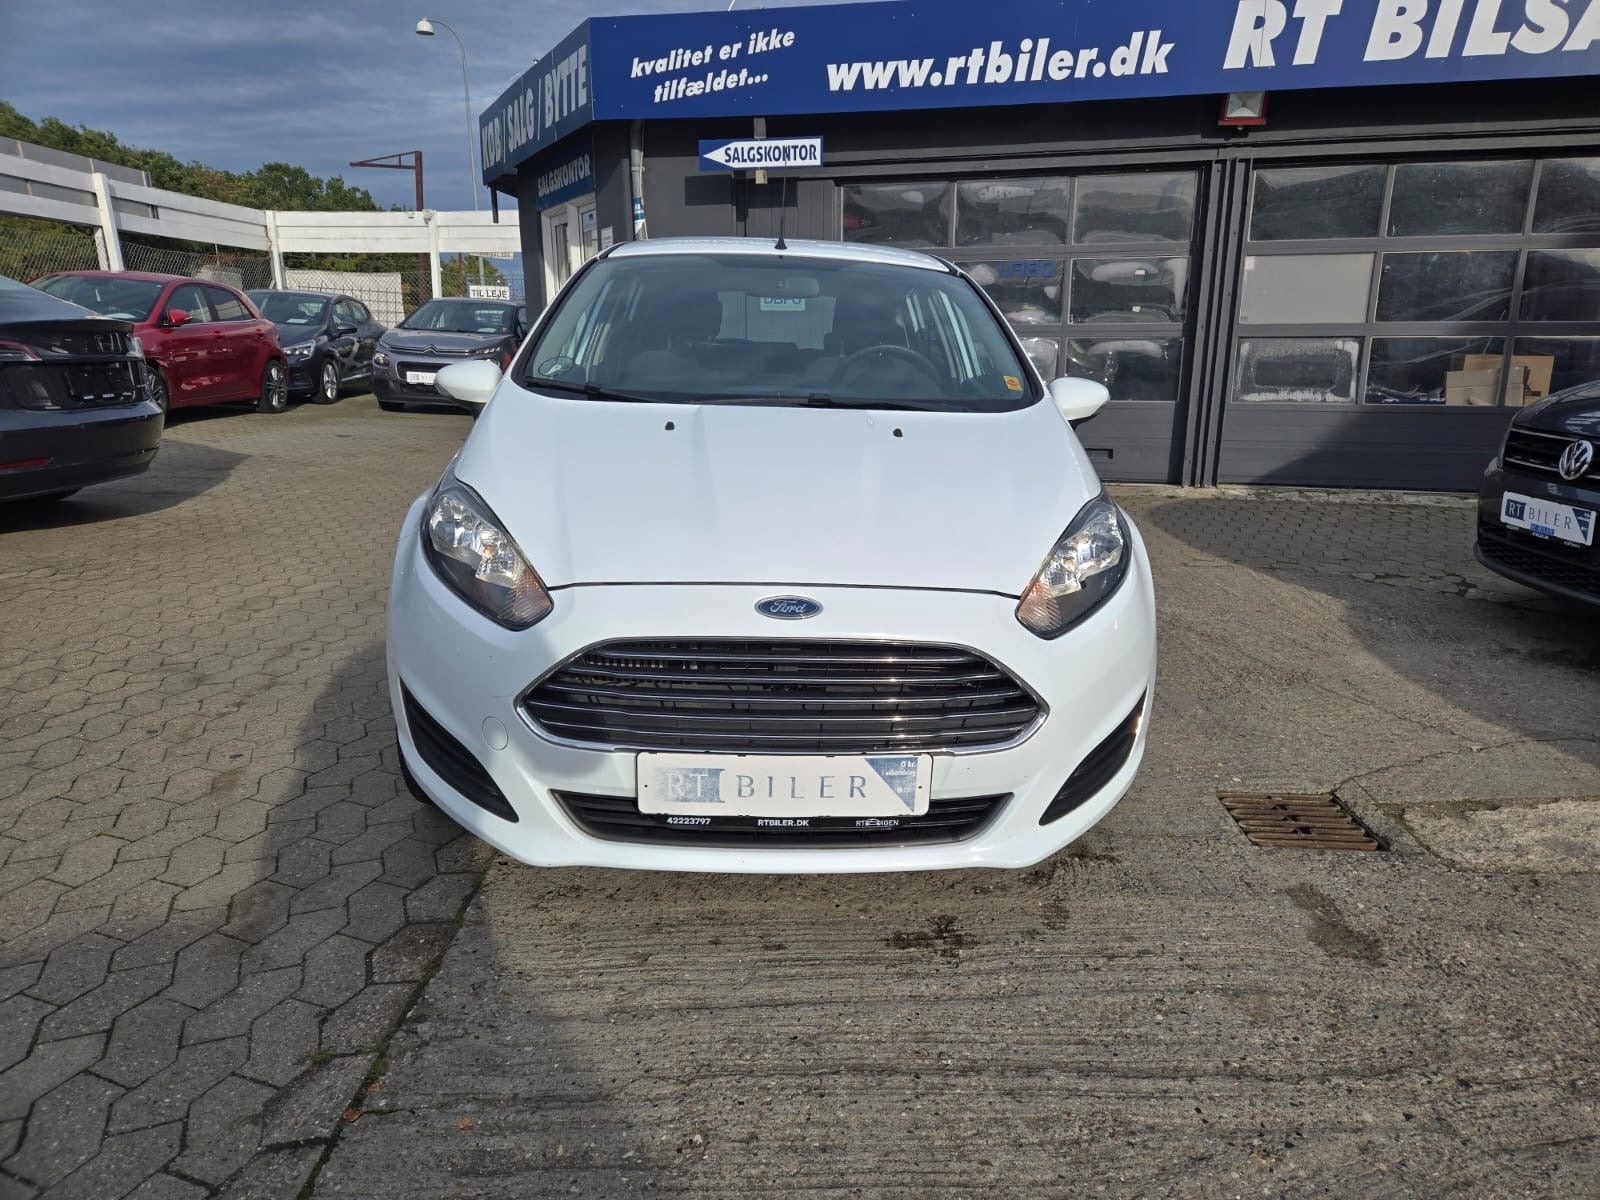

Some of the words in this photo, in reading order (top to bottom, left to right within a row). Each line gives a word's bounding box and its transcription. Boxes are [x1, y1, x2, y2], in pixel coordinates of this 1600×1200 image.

[1223, 0, 1342, 69] RT
[630, 45, 712, 78] kvalitet
[719, 42, 742, 60] er
[748, 28, 795, 54] ikke
[826, 30, 1175, 91] www.rtbiler.dk
[507, 87, 534, 153] SALG
[545, 44, 588, 128] BYTTE
[654, 68, 768, 103] tilfældet...
[724, 144, 818, 163] SALGSKONTOR
[537, 153, 591, 197] SALGSKONTOR
[486, 290, 507, 298] LEJE
[1508, 503, 1523, 517] RT
[1529, 507, 1572, 530] BILER
[769, 600, 808, 613] Ford
[668, 774, 708, 798] RT
[737, 774, 868, 798] BILER
[667, 817, 712, 825] 42223797
[757, 819, 810, 827] RTBILER.DK
